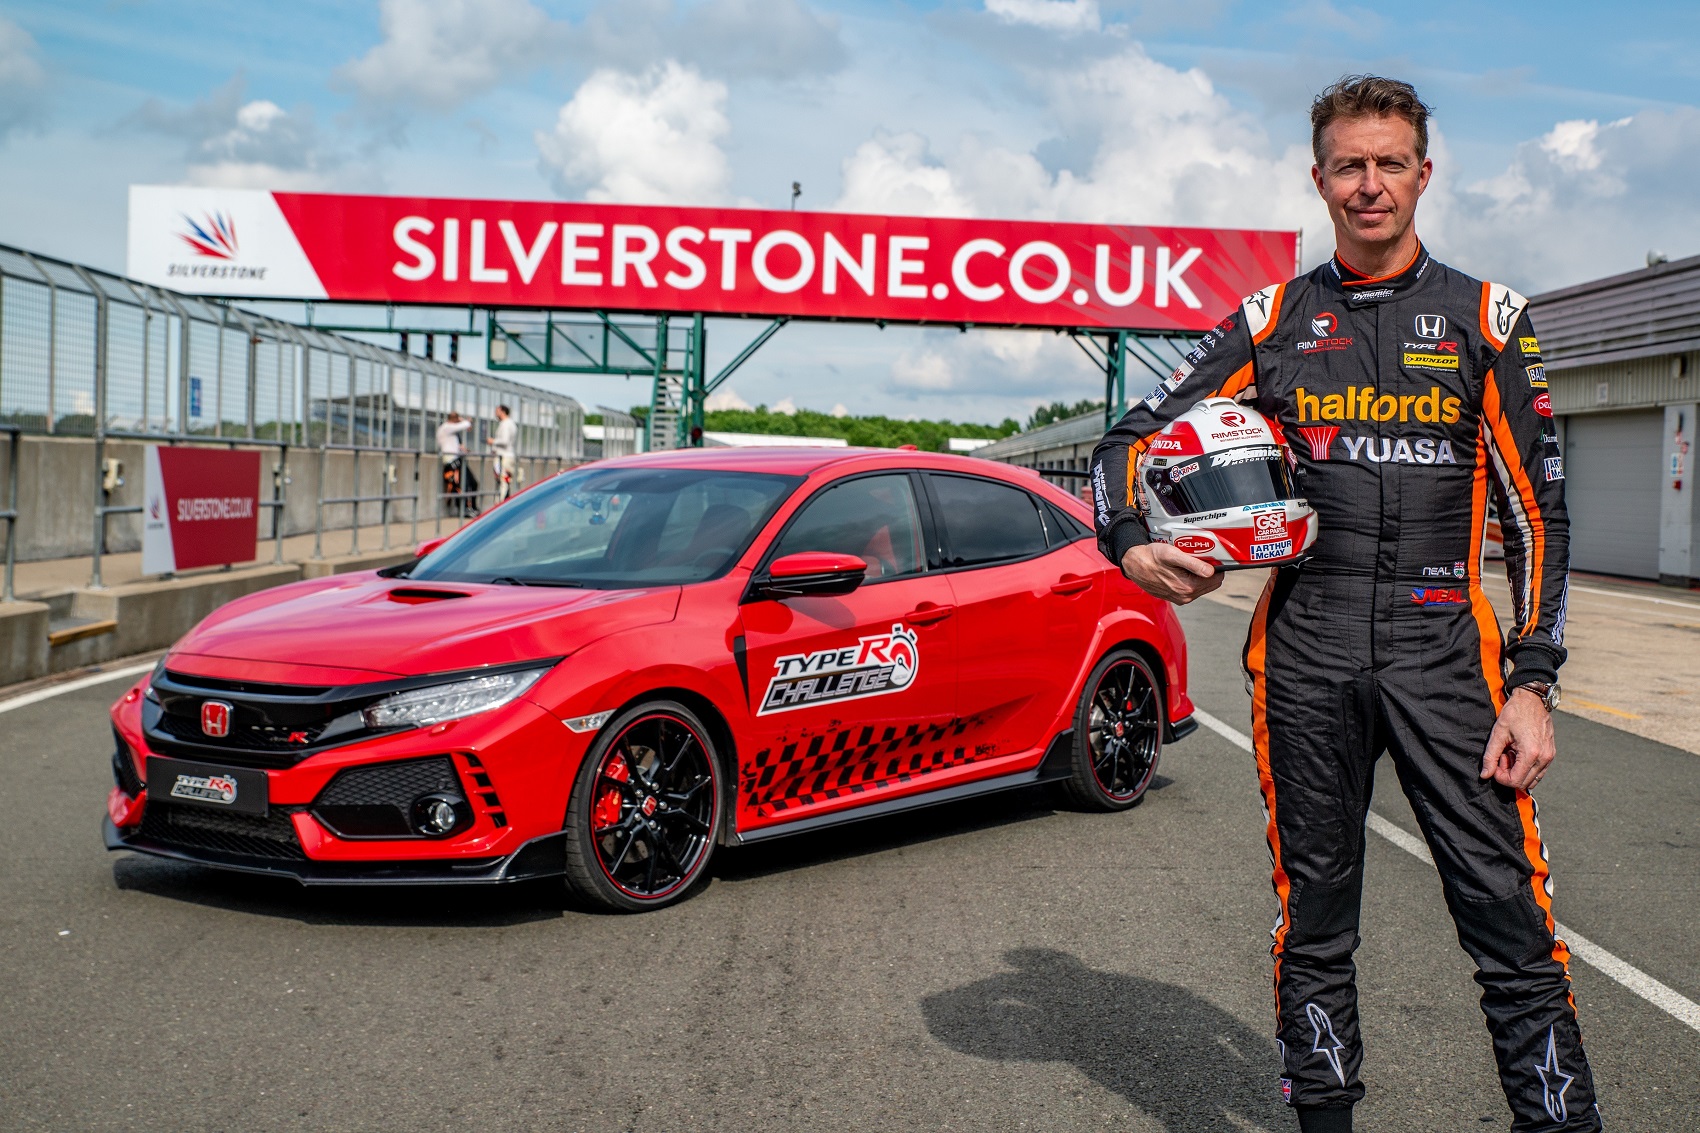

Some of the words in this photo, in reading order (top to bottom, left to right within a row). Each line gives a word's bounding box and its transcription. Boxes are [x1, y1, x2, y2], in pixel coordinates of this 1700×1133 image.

[392, 216, 1202, 309] SILVERSTONE.CO.UK
[168, 263, 267, 280] SILVERSTONE
[1297, 338, 1353, 350] RIMSTOCK
[1404, 342, 1437, 350] TYPE
[1437, 341, 1459, 354] R
[1414, 356, 1457, 365] DUNLOP
[1295, 386, 1462, 424] halfords
[1211, 427, 1264, 439] RIMSTOCK
[1341, 436, 1457, 464] YUASA
[177, 497, 254, 521] SILVERSTONE.CO.UK
[1183, 512, 1228, 524] Superchips
[1256, 513, 1285, 530] GSF
[1255, 540, 1292, 552] ARTHUR
[1255, 549, 1285, 559] McKAY
[778, 649, 856, 676] TYPE
[857, 637, 891, 664] R
[766, 668, 893, 707] CHALLENGE
